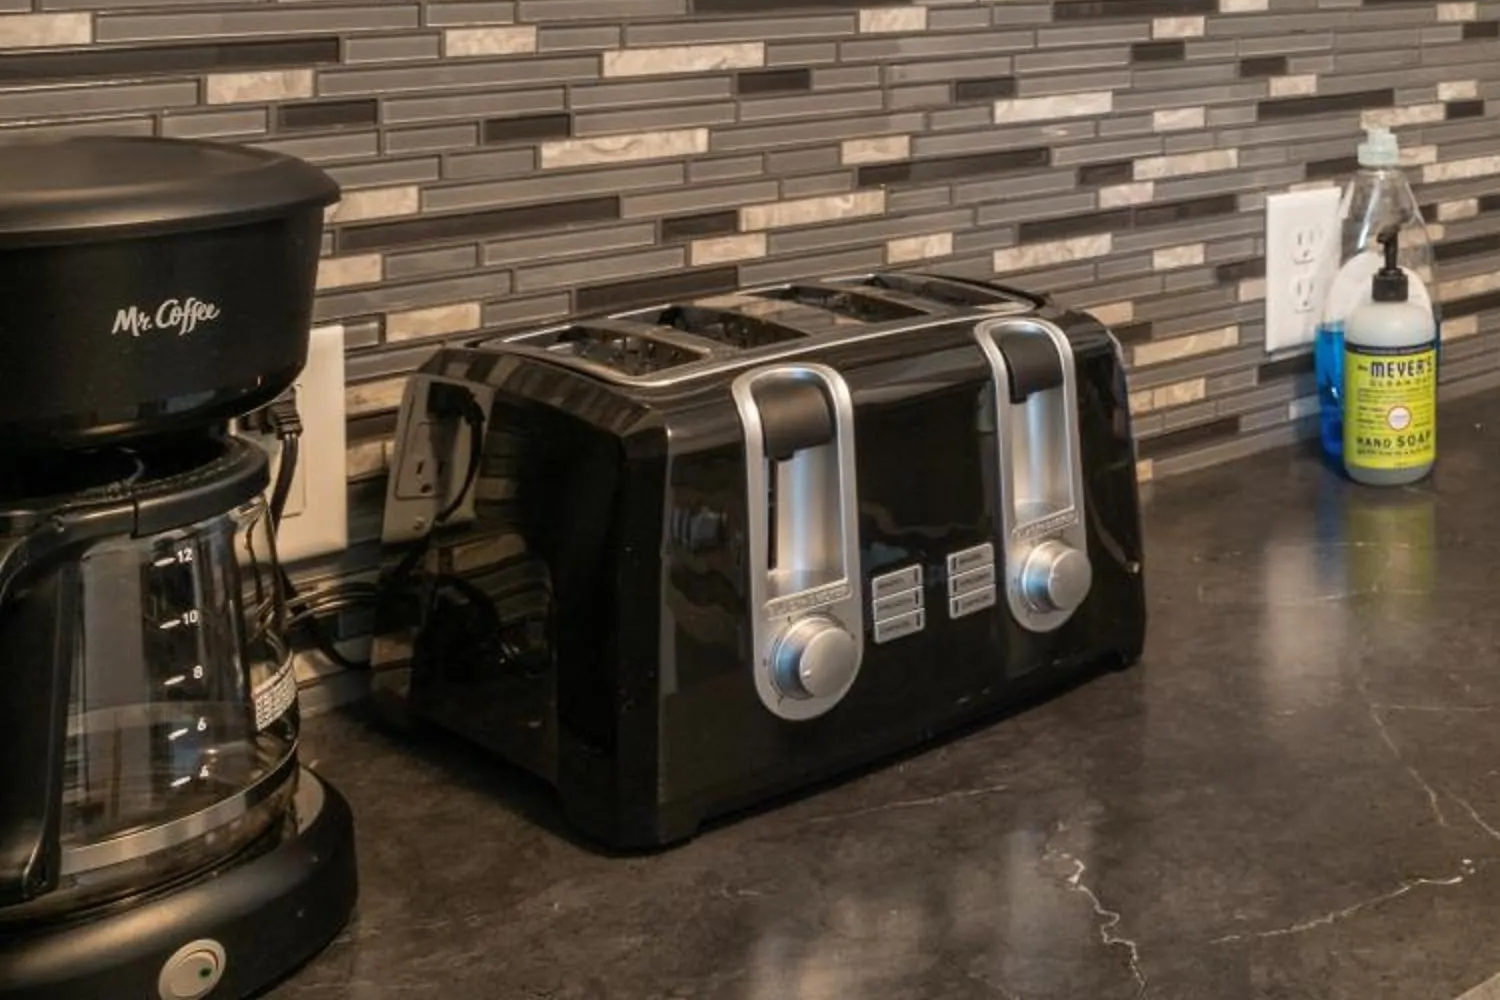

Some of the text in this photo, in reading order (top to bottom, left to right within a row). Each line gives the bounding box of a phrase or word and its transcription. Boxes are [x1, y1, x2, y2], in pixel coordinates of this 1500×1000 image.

[111, 297, 220, 337] Mr. Coffee
[177, 548, 193, 563] 12
[182, 609, 199, 625] 10
[197, 717, 207, 732] 6
